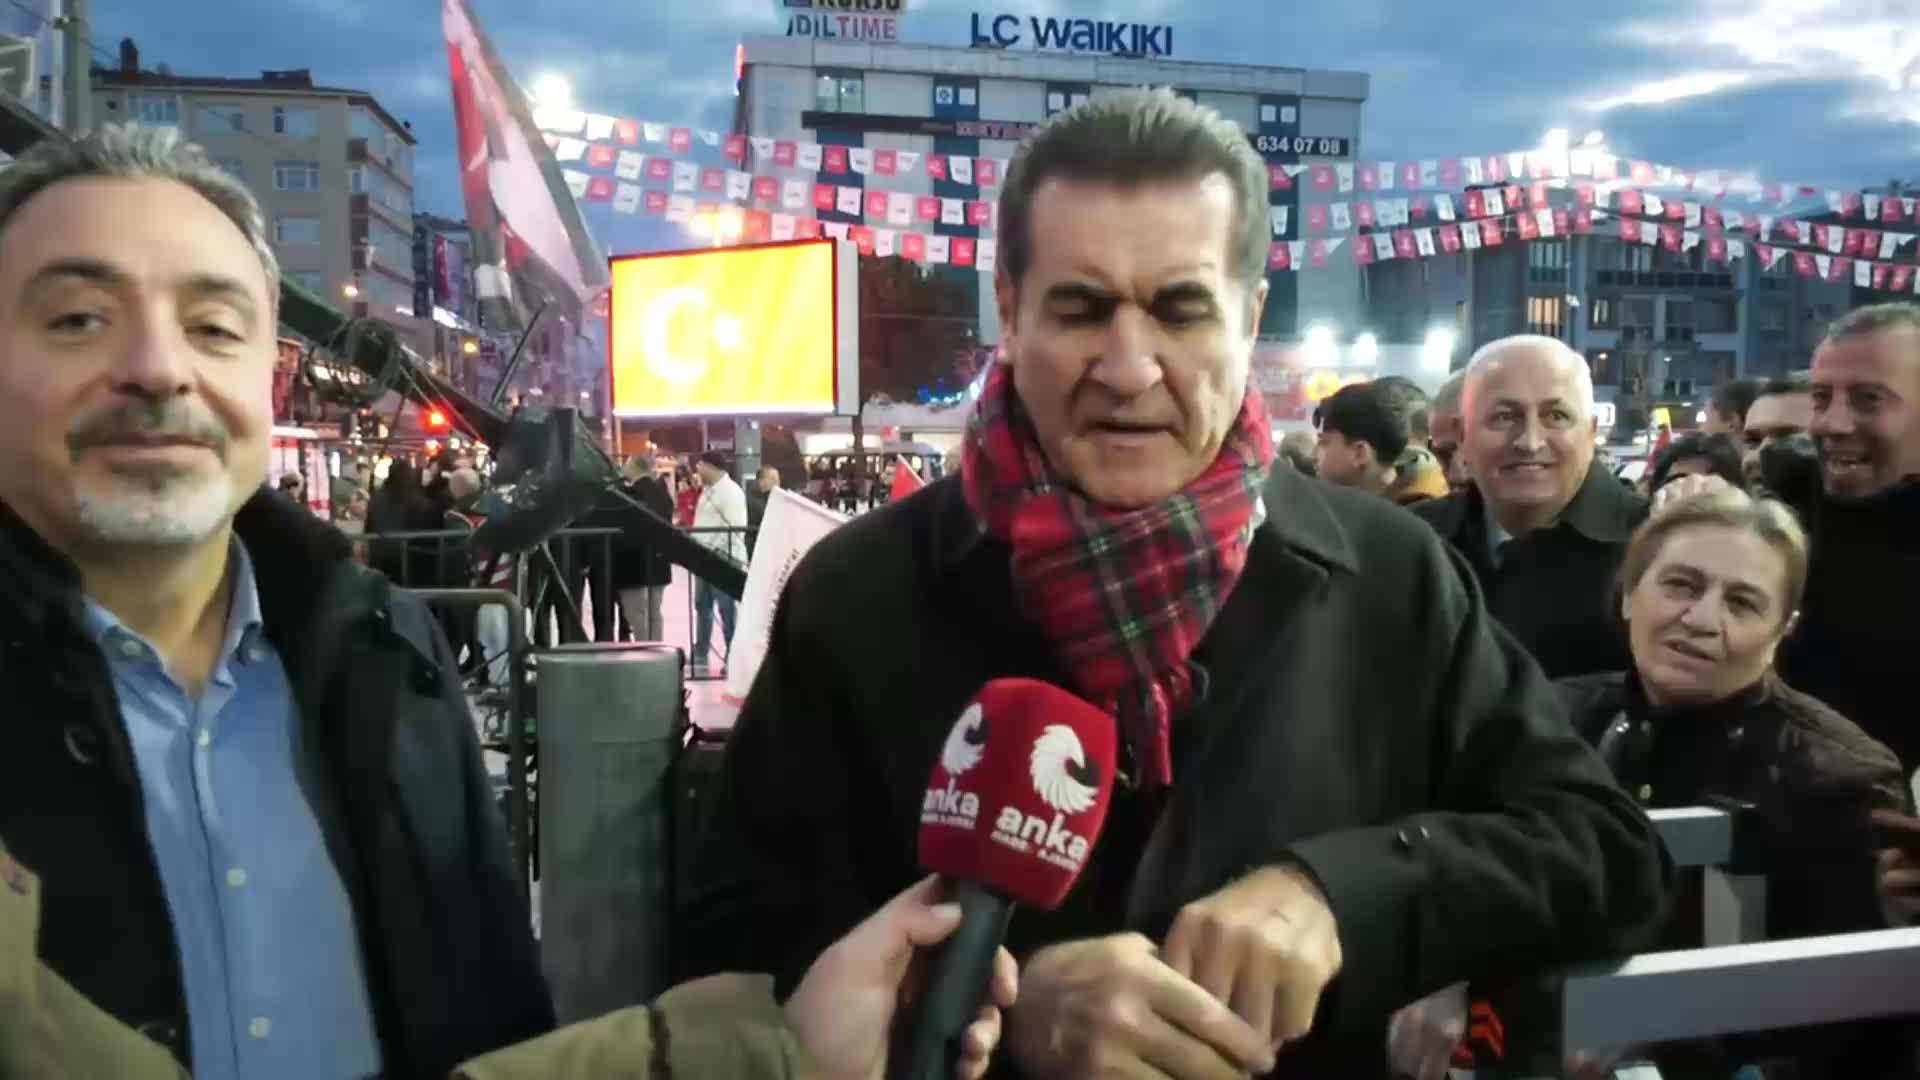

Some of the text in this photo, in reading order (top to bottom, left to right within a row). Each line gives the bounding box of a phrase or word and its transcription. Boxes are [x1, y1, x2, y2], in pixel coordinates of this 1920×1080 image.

[970, 12, 1020, 48] LC
[1257, 135, 1290, 153] 634
[1293, 136, 1314, 153] 07
[996, 806, 1089, 861] anka
